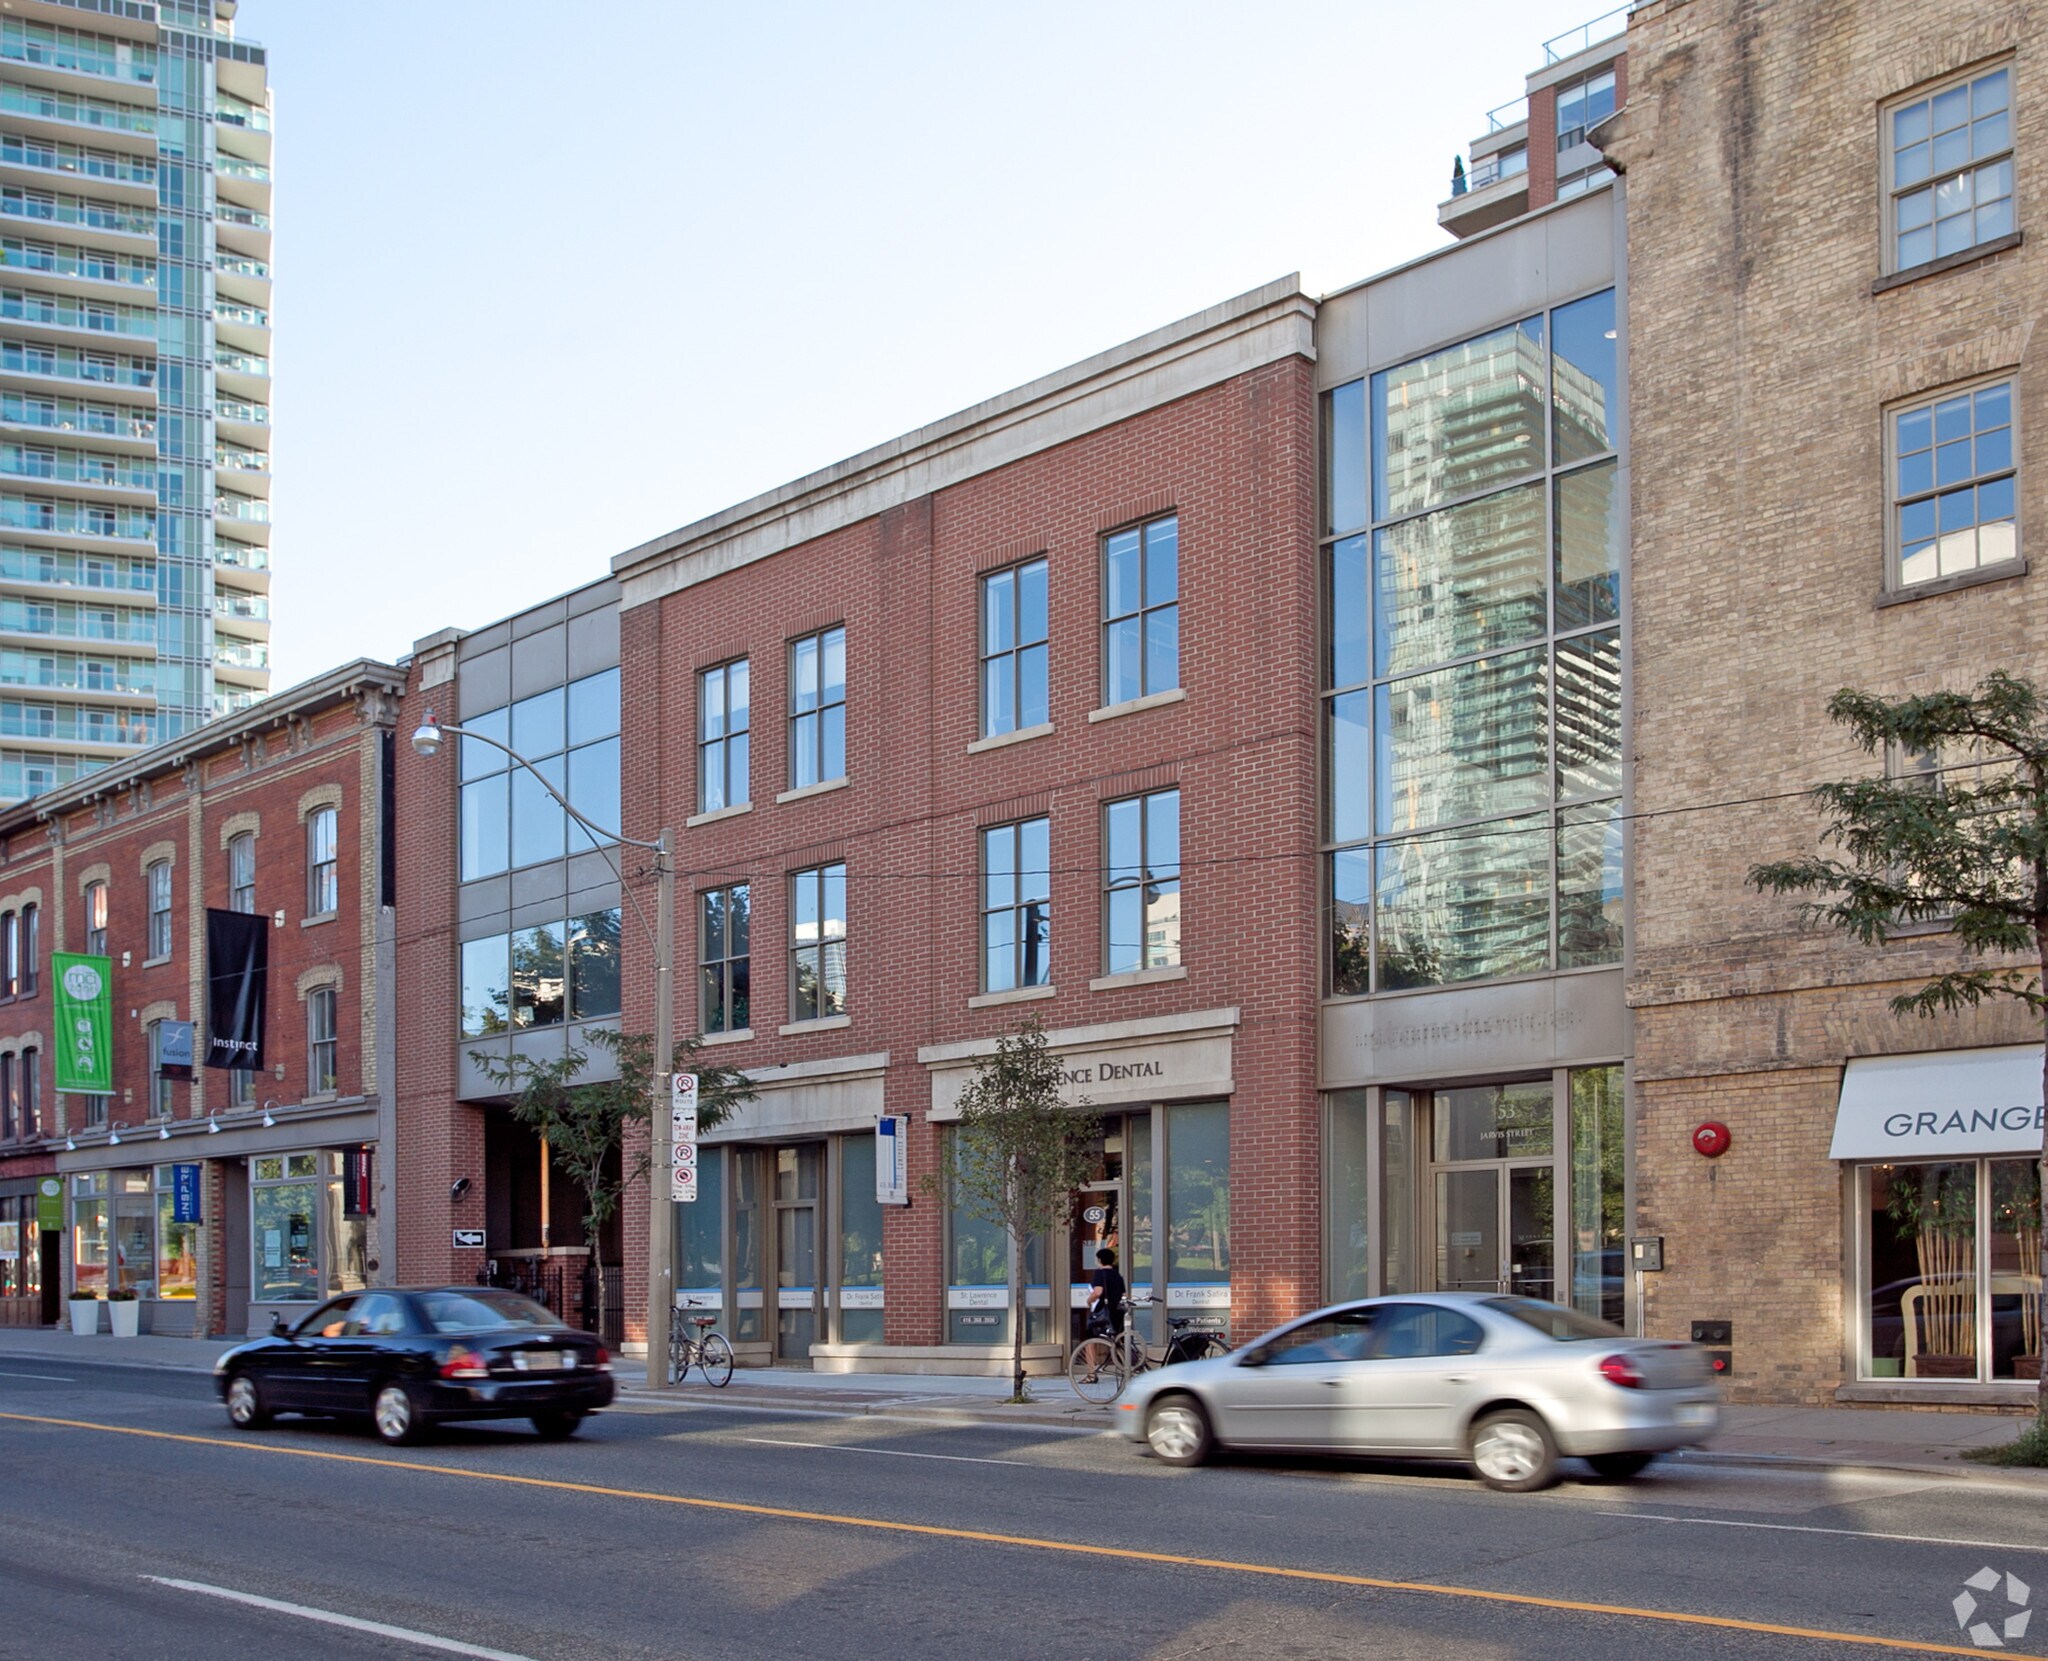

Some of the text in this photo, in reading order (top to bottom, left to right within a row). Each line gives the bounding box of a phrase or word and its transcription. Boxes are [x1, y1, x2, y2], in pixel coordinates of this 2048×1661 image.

[162, 1047, 190, 1057] fusion
[1497, 1103, 1515, 1119] 53
[1480, 1130, 1505, 1140] JARVIS
[1506, 1128, 1535, 1138] STREET
[181, 1166, 190, 1215] INSPIRE
[1089, 1209, 1101, 1220] 55
[970, 1291, 997, 1299] Lawrence
[1186, 1289, 1205, 1298] Frank
